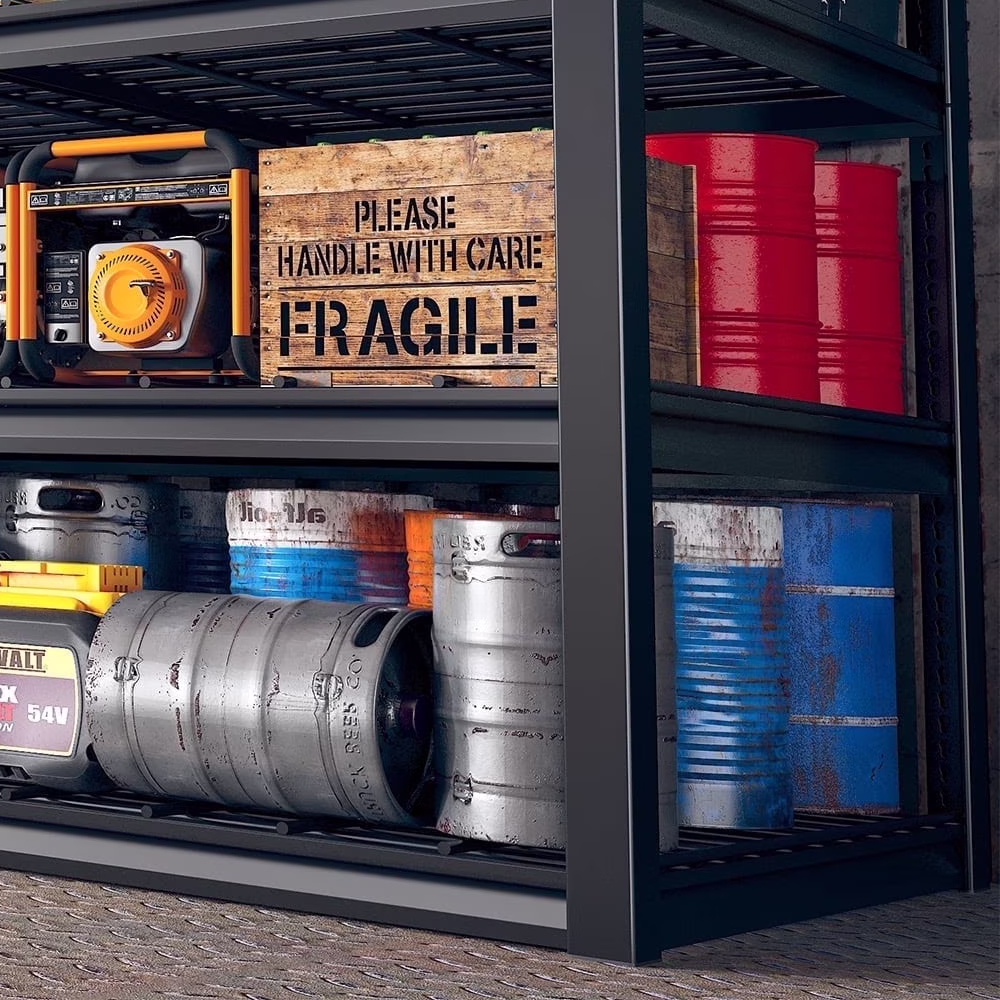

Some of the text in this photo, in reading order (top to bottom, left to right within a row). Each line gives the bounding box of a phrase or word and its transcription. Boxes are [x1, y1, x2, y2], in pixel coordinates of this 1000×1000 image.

[354, 195, 456, 233] PLEASE
[277, 235, 543, 278] HANDLE WITH CARE
[280, 294, 538, 357] FRAGILE
[27, 703, 69, 725] 54V
